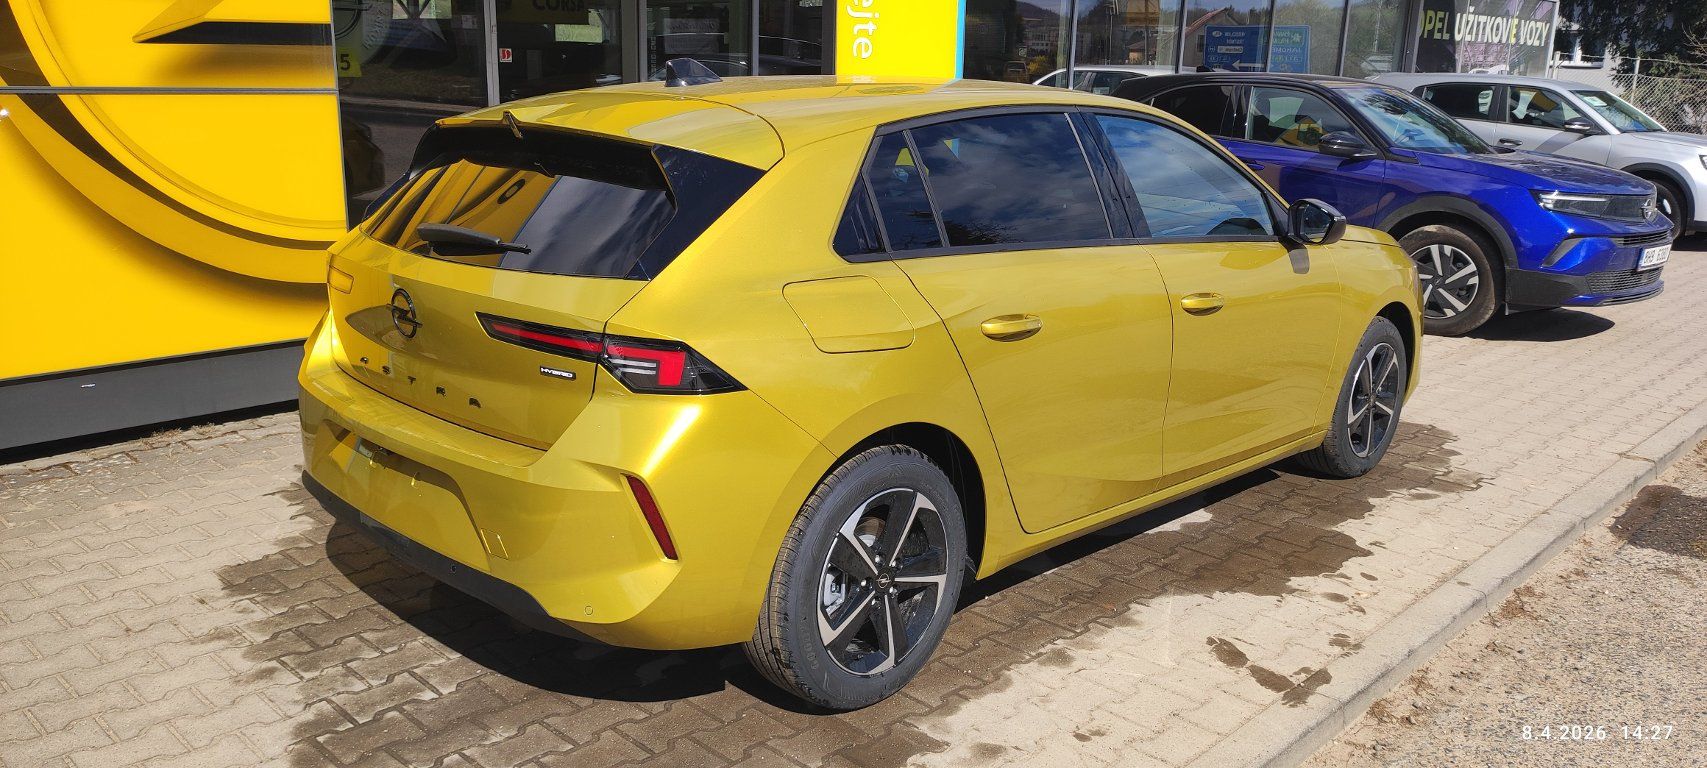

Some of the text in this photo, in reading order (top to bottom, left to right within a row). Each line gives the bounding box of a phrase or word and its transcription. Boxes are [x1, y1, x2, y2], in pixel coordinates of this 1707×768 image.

[1519, 19, 1551, 47] VOZY
[359, 356, 481, 408] ASTRA
[540, 367, 574, 378] HYBRID
